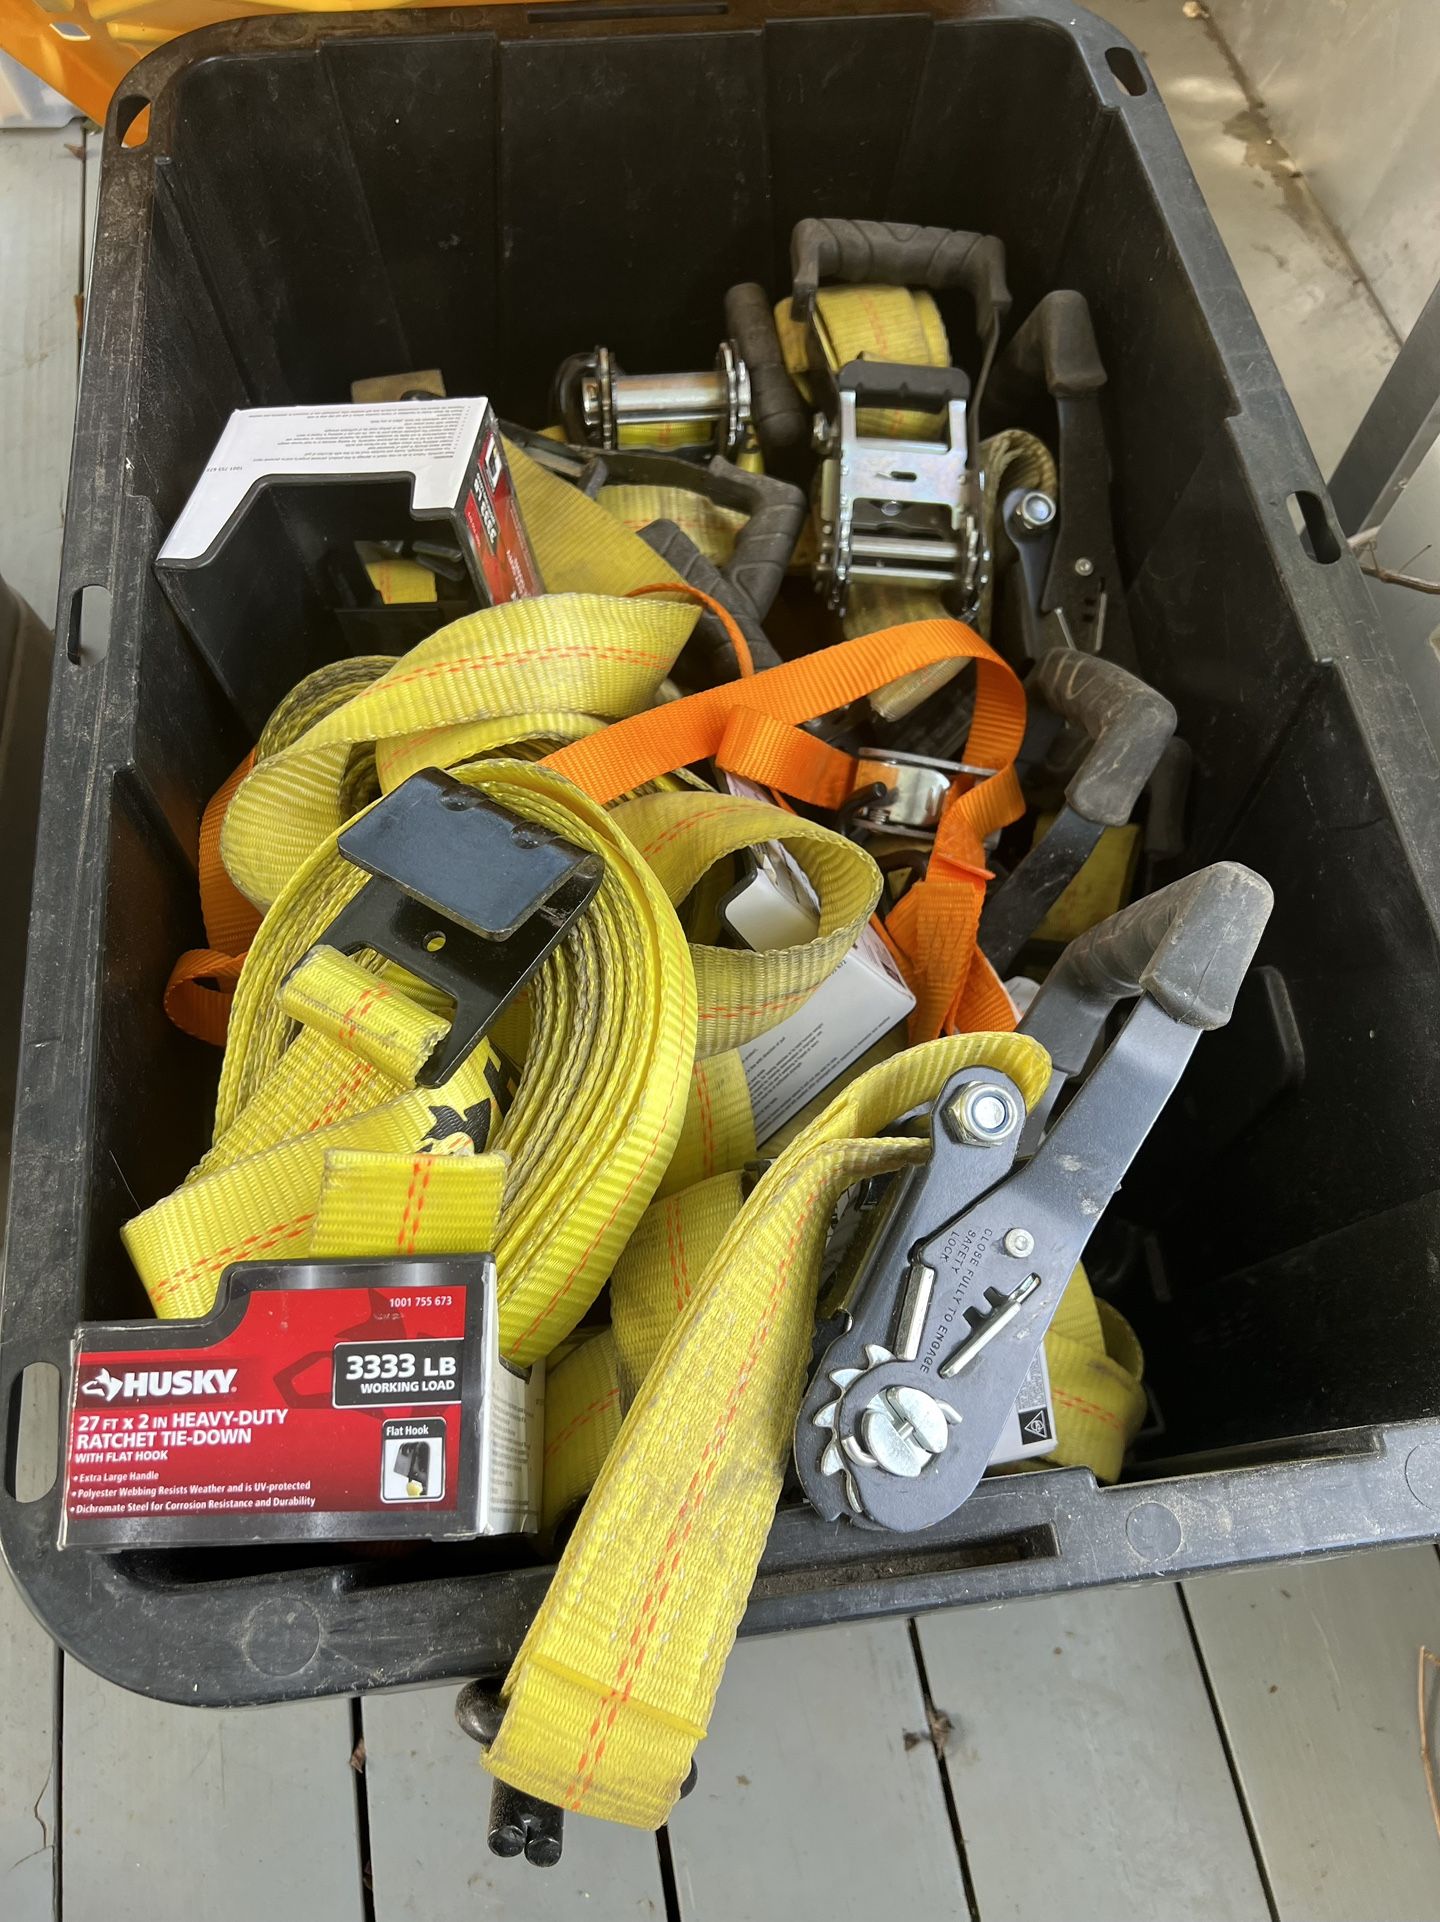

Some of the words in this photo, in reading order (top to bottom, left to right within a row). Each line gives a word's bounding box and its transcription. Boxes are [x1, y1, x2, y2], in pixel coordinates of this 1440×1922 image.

[940, 1231, 960, 1263] LOCK
[951, 1230, 977, 1274] SAFETY
[970, 1228, 993, 1267] CLOSE
[953, 1269, 975, 1305] FULLY
[389, 1297, 412, 1307] 1001
[415, 1297, 433, 1307] 755
[434, 1296, 453, 1306] 673
[944, 1307, 957, 1323] TO
[920, 1325, 949, 1374] ENGAGE
[346, 1353, 416, 1380] 3333
[423, 1356, 457, 1377] LB
[123, 1368, 237, 1397] HUSKY
[360, 1381, 420, 1394] WORKING
[421, 1380, 456, 1392] LOAD
[78, 1416, 99, 1432] 27
[102, 1417, 119, 1430] FT
[138, 1414, 149, 1429] 2
[153, 1416, 168, 1428] IN
[172, 1408, 288, 1429] HEAVY-DUTY
[386, 1425, 403, 1436] Flat
[405, 1424, 429, 1436] Hook
[77, 1431, 157, 1449] RATCHET
[161, 1428, 252, 1446] TIE-DOWN
[75, 1452, 103, 1464] WITH
[105, 1451, 132, 1462] FLAT
[135, 1450, 168, 1462] HOOK
[80, 1473, 102, 1482] Extra
[103, 1472, 128, 1483] Large
[129, 1471, 160, 1481] Handle
[78, 1488, 117, 1499] Polyester
[119, 1486, 157, 1498] Webbing
[158, 1485, 188, 1495] Resists
[189, 1483, 225, 1494] Weather
[226, 1482, 243, 1493] and
[244, 1482, 253, 1492] is
[254, 1480, 311, 1493] UV-protected
[76, 1503, 126, 1514] Dichromate
[127, 1501, 149, 1512] Steel
[150, 1501, 163, 1511] for
[165, 1499, 207, 1511] Corrosion
[208, 1498, 253, 1509] Resistance
[254, 1497, 272, 1507] and
[273, 1496, 316, 1507] Durability
